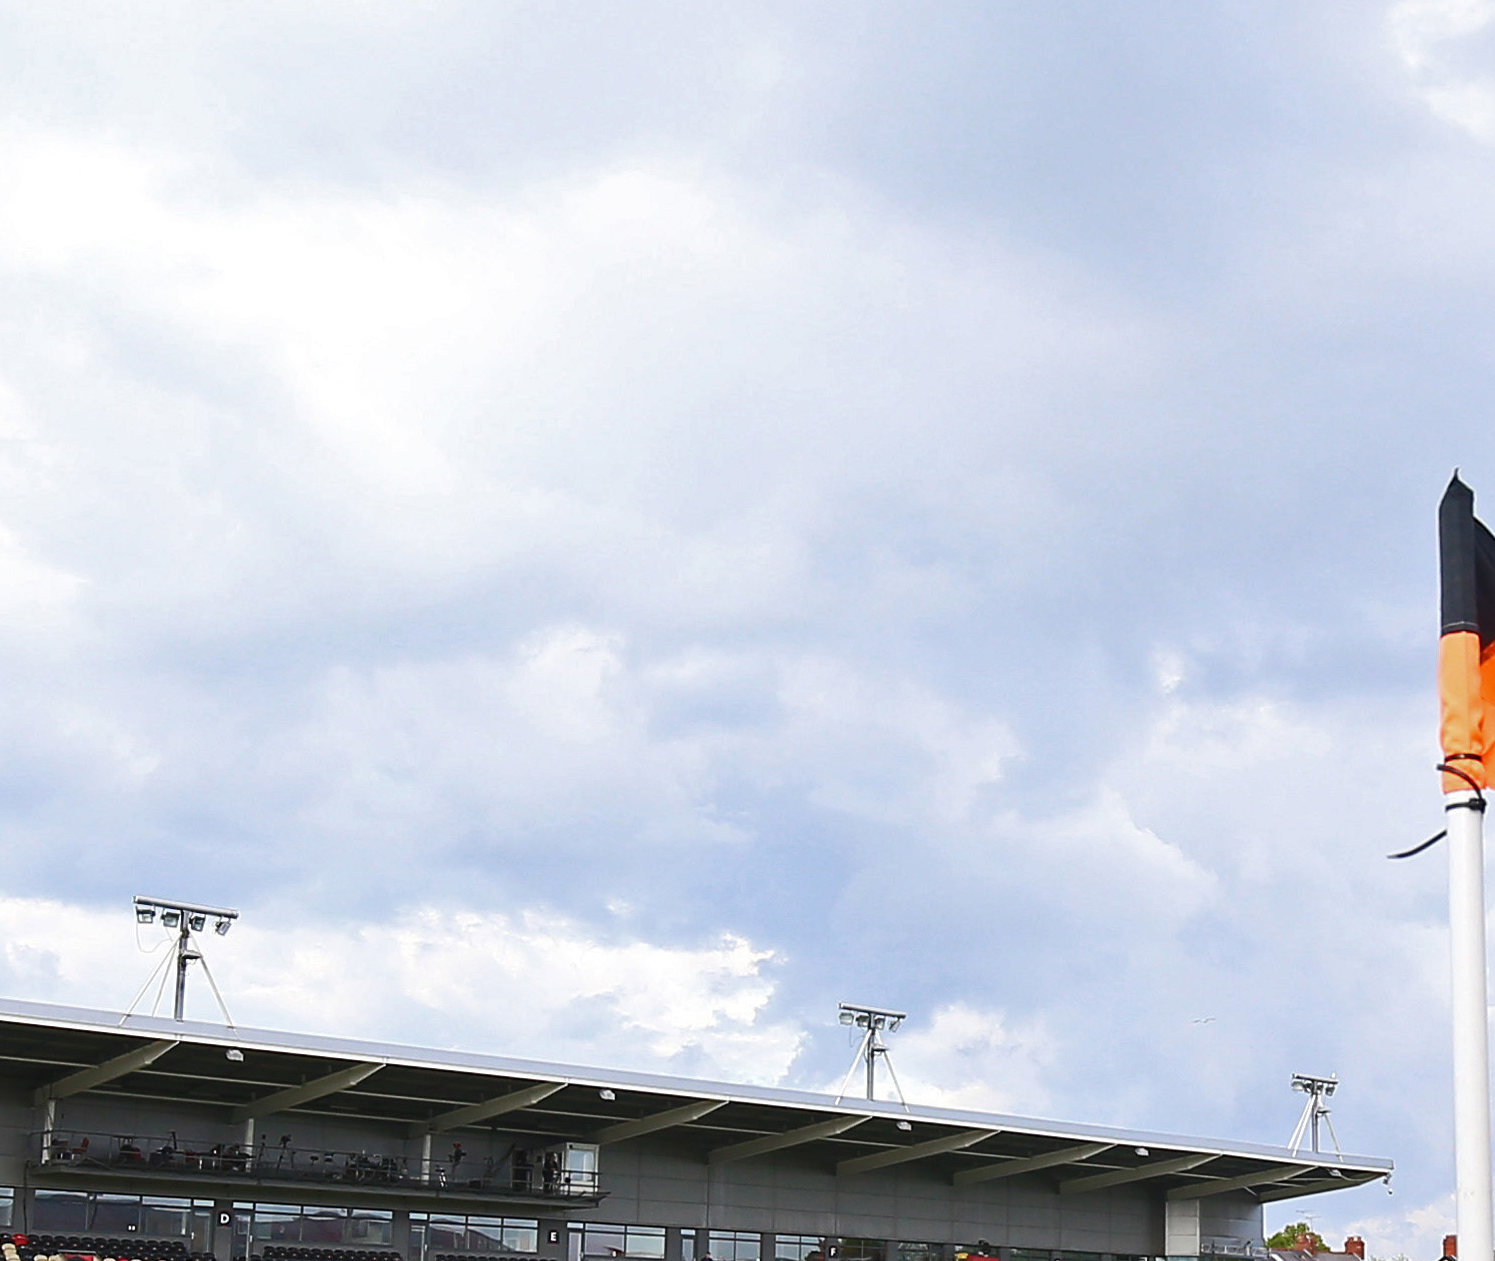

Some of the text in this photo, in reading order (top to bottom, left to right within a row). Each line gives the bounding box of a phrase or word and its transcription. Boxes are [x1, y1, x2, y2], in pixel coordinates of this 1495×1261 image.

[220, 1213, 230, 1224] D
[550, 1232, 557, 1241] E
[830, 1247, 837, 1256] F
